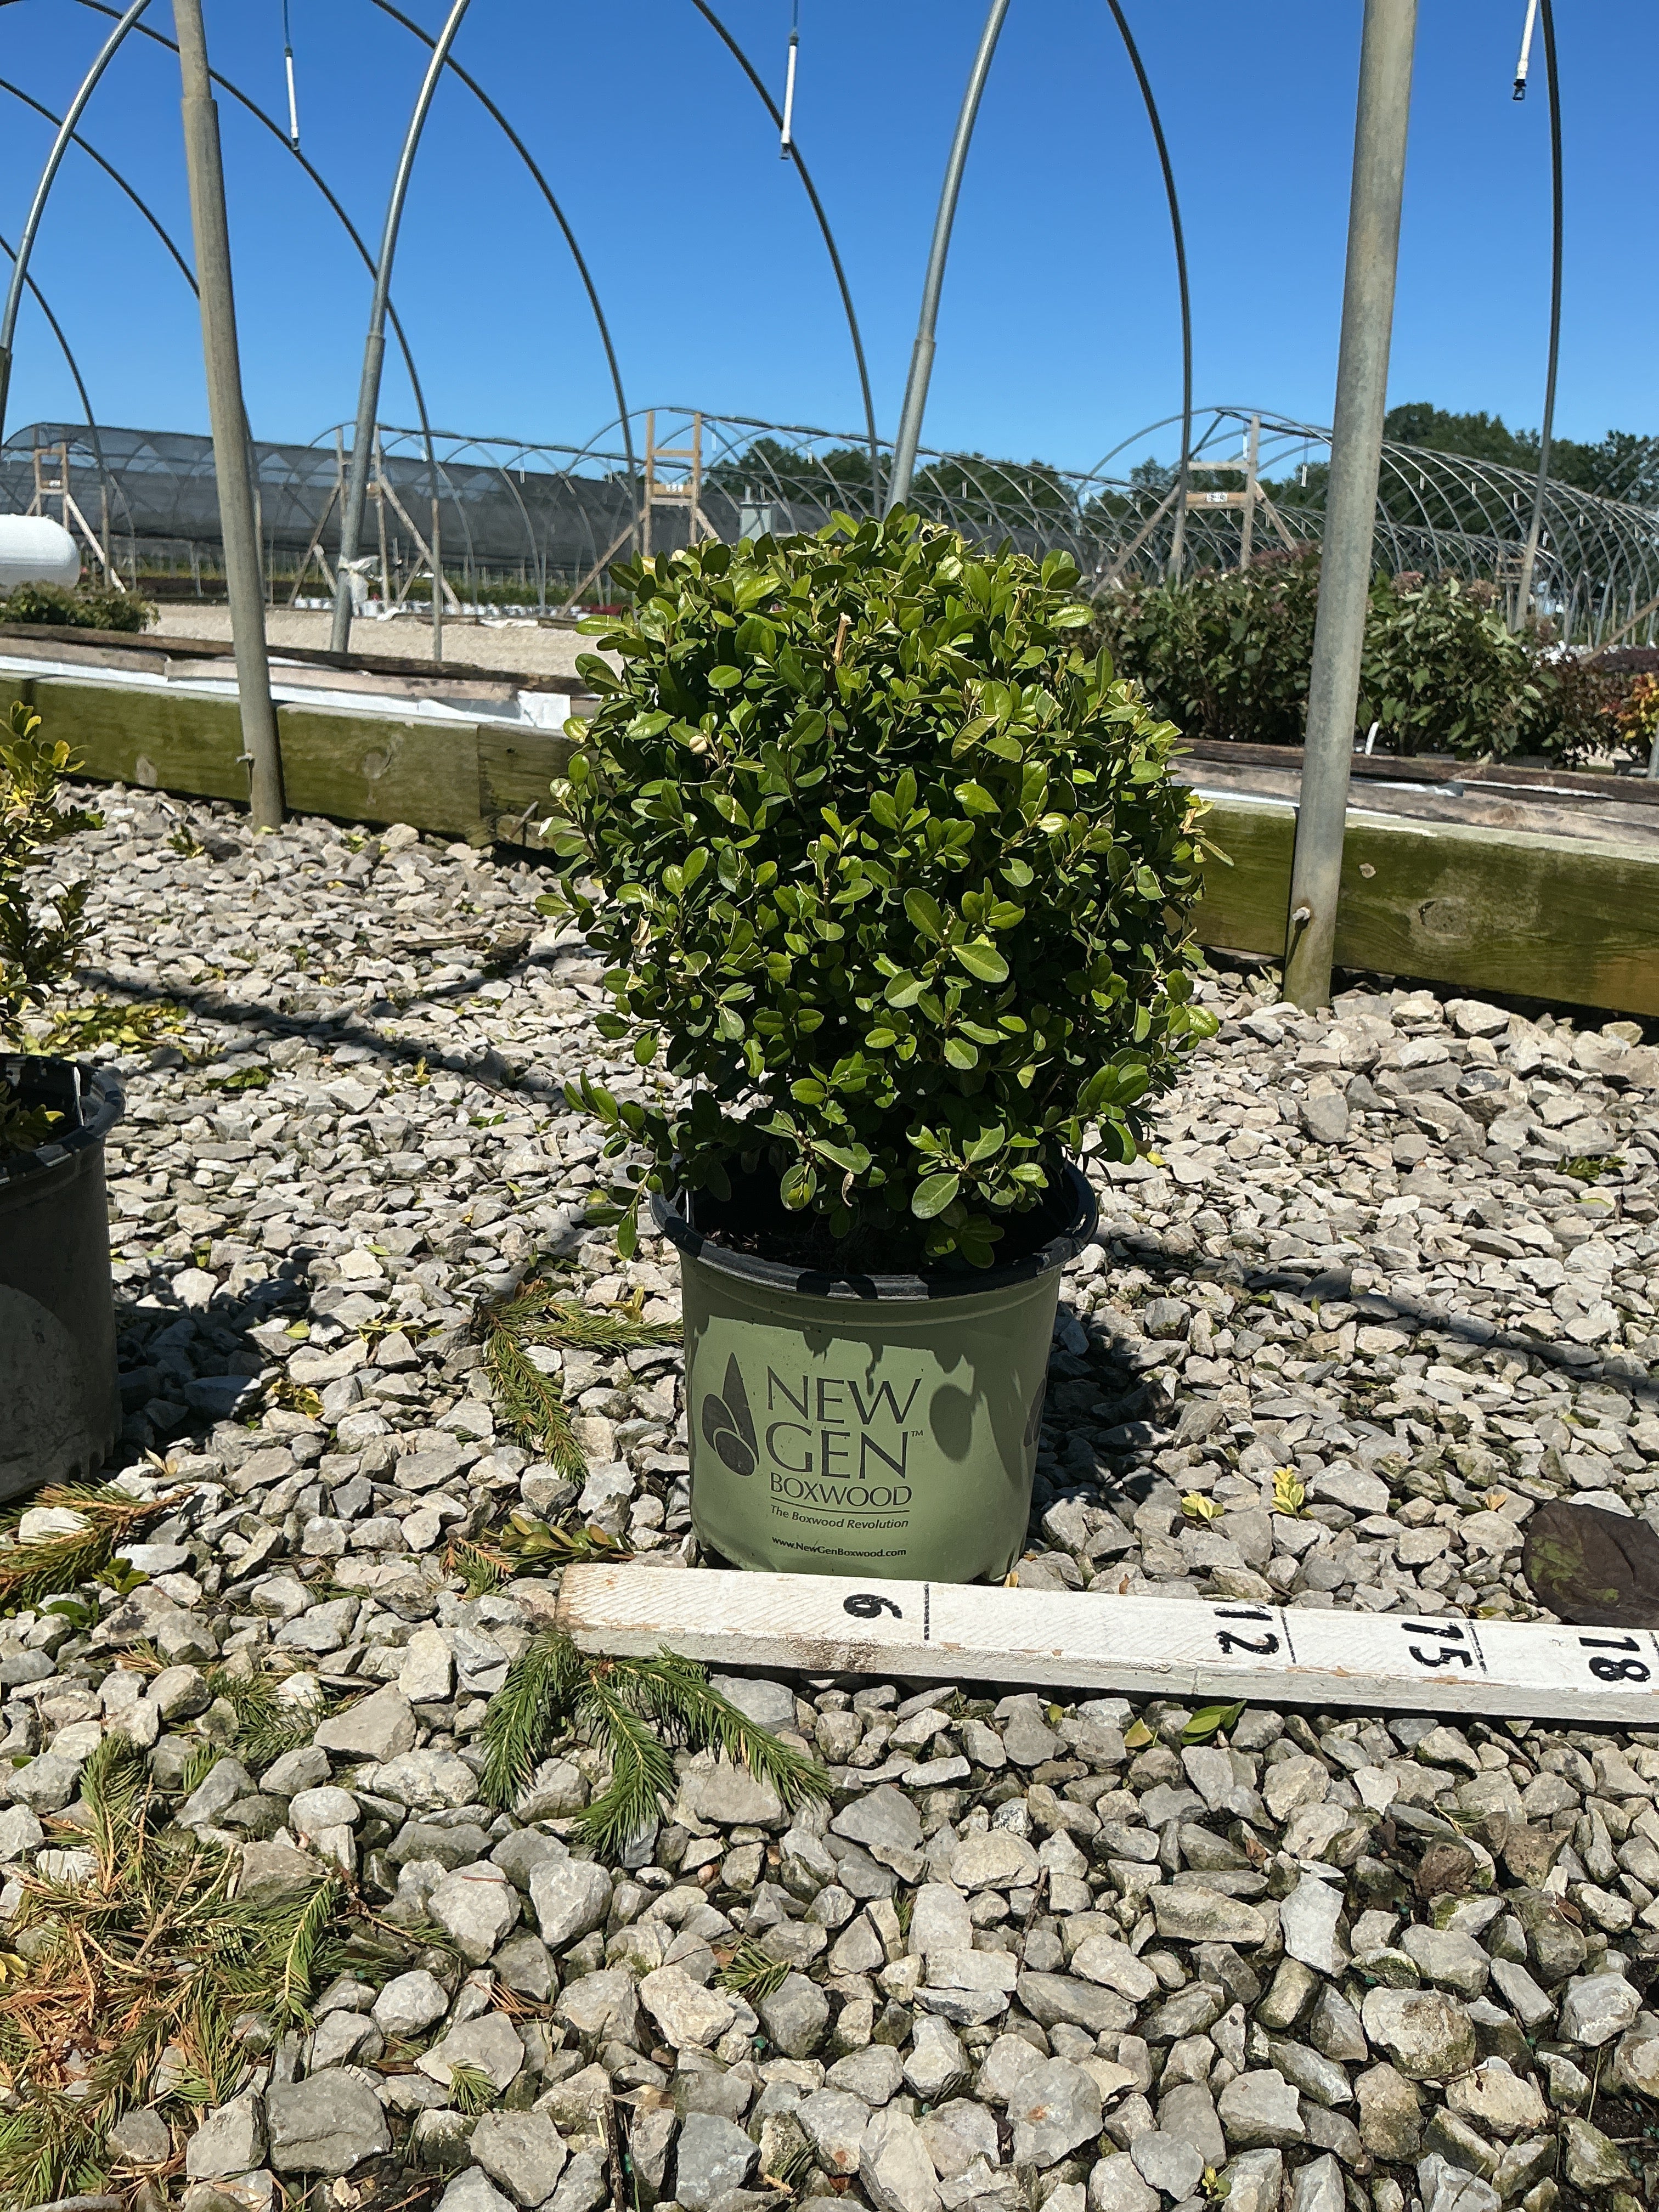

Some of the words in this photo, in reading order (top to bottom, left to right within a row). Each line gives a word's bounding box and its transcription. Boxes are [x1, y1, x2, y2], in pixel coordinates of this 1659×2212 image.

[768, 1365, 922, 1425] NEW
[766, 1422, 908, 1479] GEN
[770, 1472, 912, 1506] BOXWOOD
[771, 1504, 789, 1518] The
[792, 1511, 844, 1528] Boxwood
[847, 1519, 909, 1529] Revolution
[772, 1537, 906, 1557] www.NewGenBoxwood.com
[843, 1594, 902, 1618] 6
[1214, 1605, 1279, 1655] 12
[1401, 1622, 1473, 1668] 15
[1578, 1636, 1651, 1682] 18
